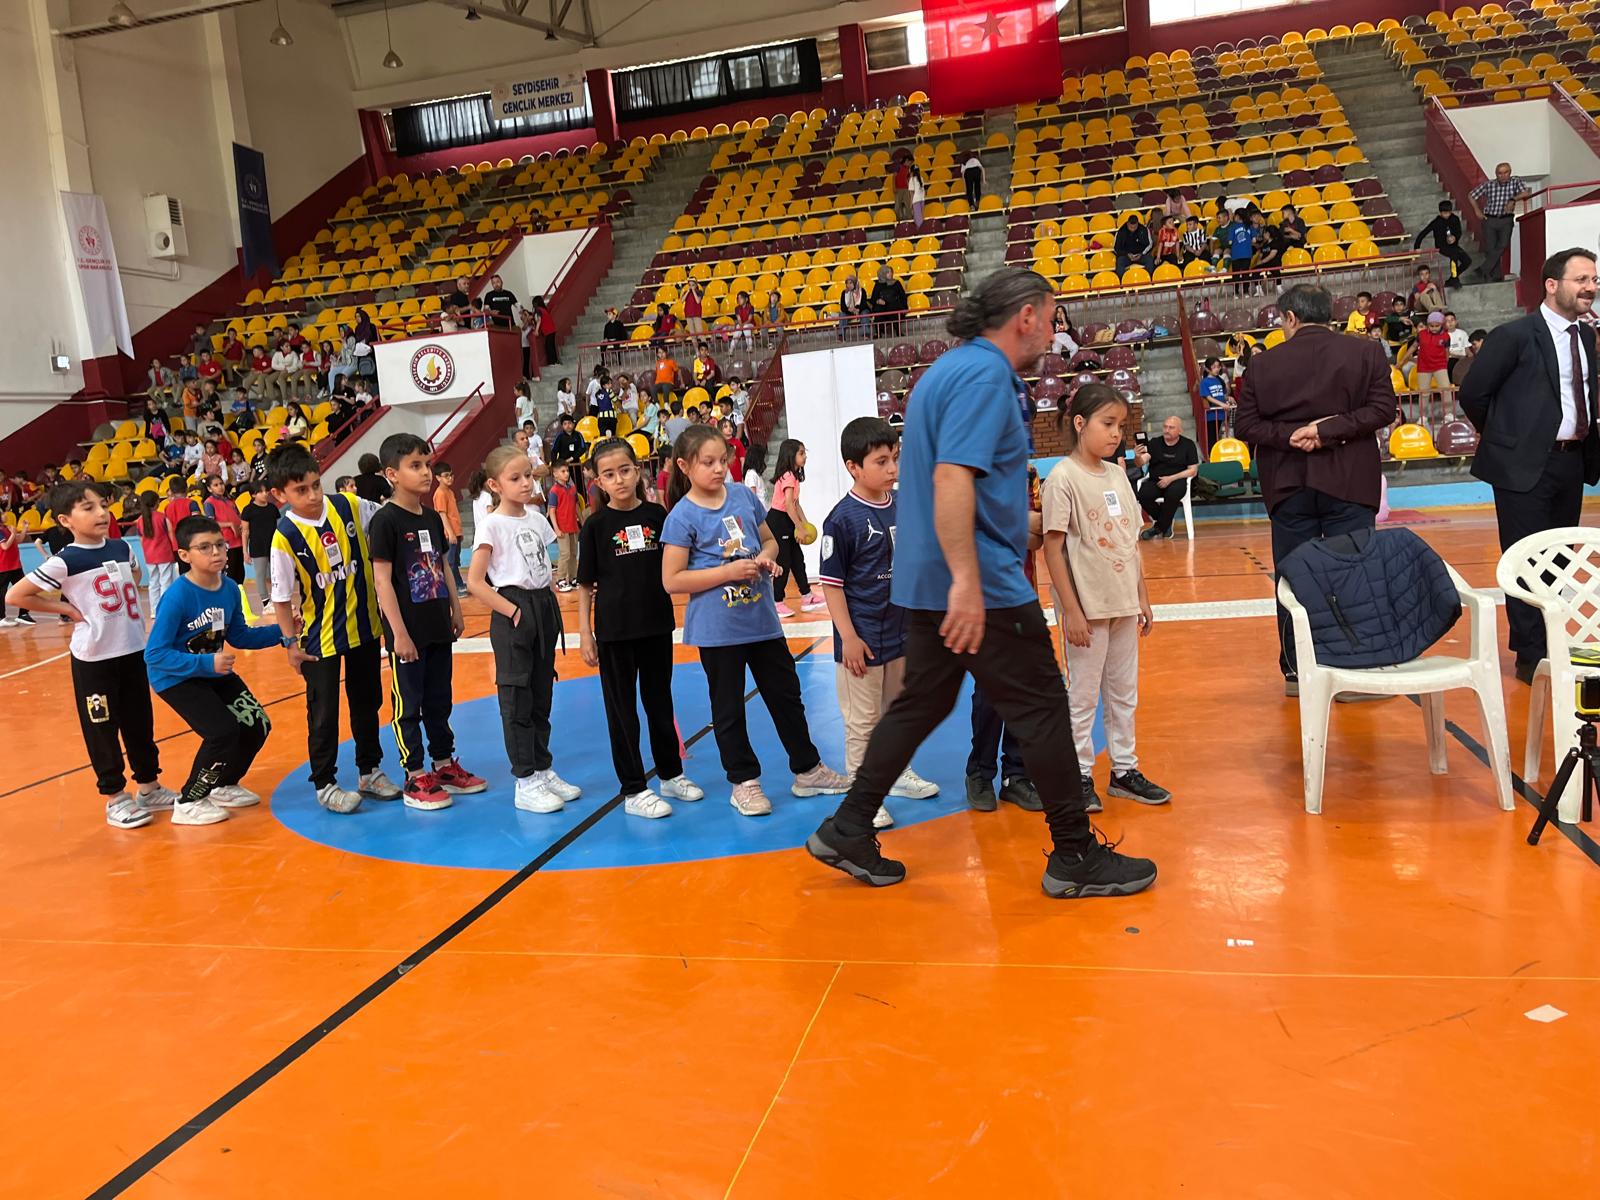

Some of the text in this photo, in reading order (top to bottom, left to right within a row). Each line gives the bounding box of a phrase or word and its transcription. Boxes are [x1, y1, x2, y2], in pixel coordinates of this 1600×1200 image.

[512, 78, 559, 96] SEYDİŞEHİR
[502, 91, 574, 114] GENÇLİK MERKEZİ
